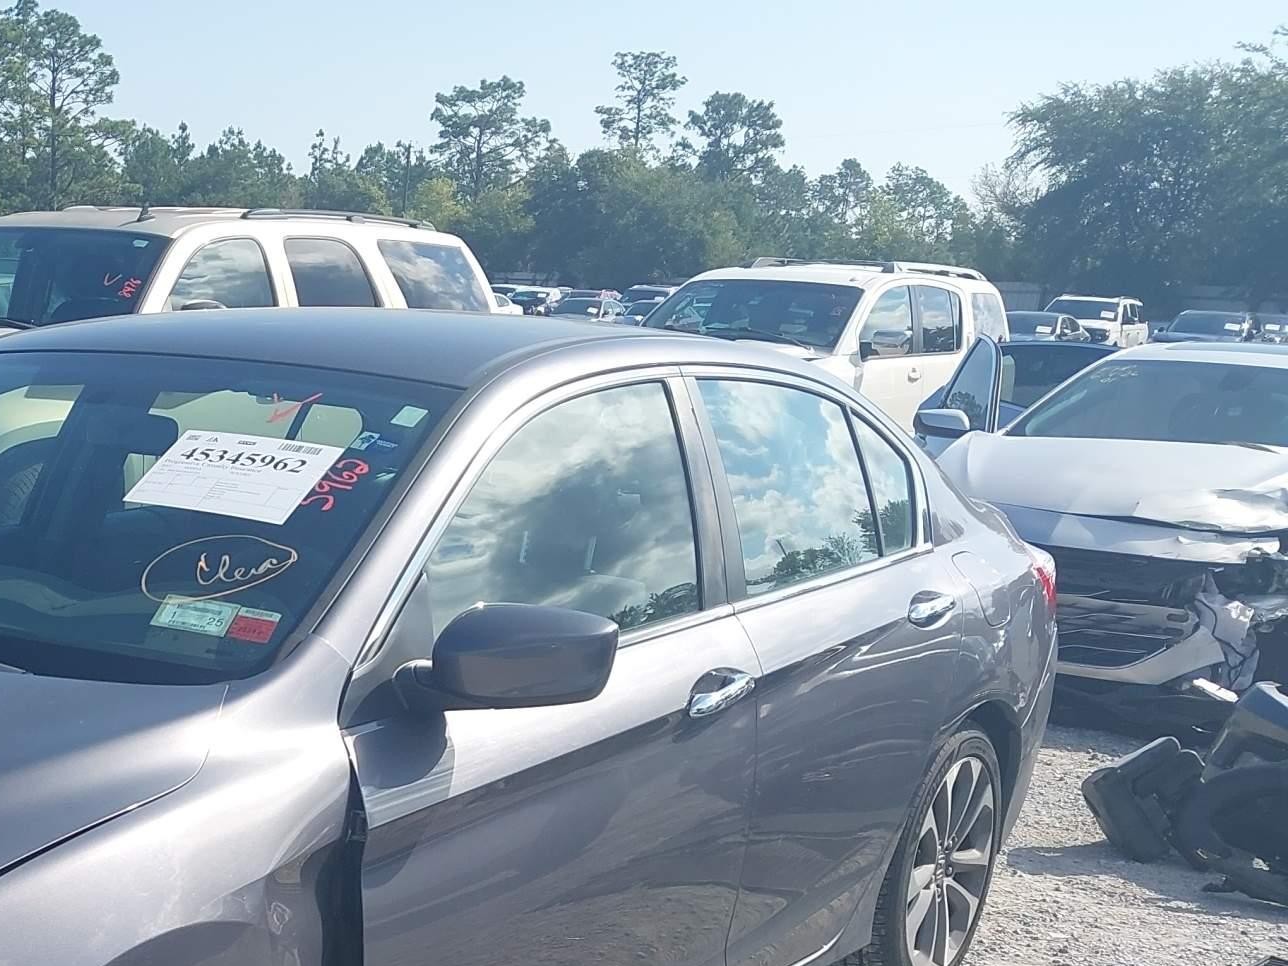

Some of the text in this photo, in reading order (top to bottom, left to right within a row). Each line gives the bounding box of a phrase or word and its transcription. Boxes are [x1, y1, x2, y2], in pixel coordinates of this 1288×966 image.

[180, 446, 308, 474] 45345962
[300, 458, 370, 511] 5962
[205, 616, 224, 628] 25
